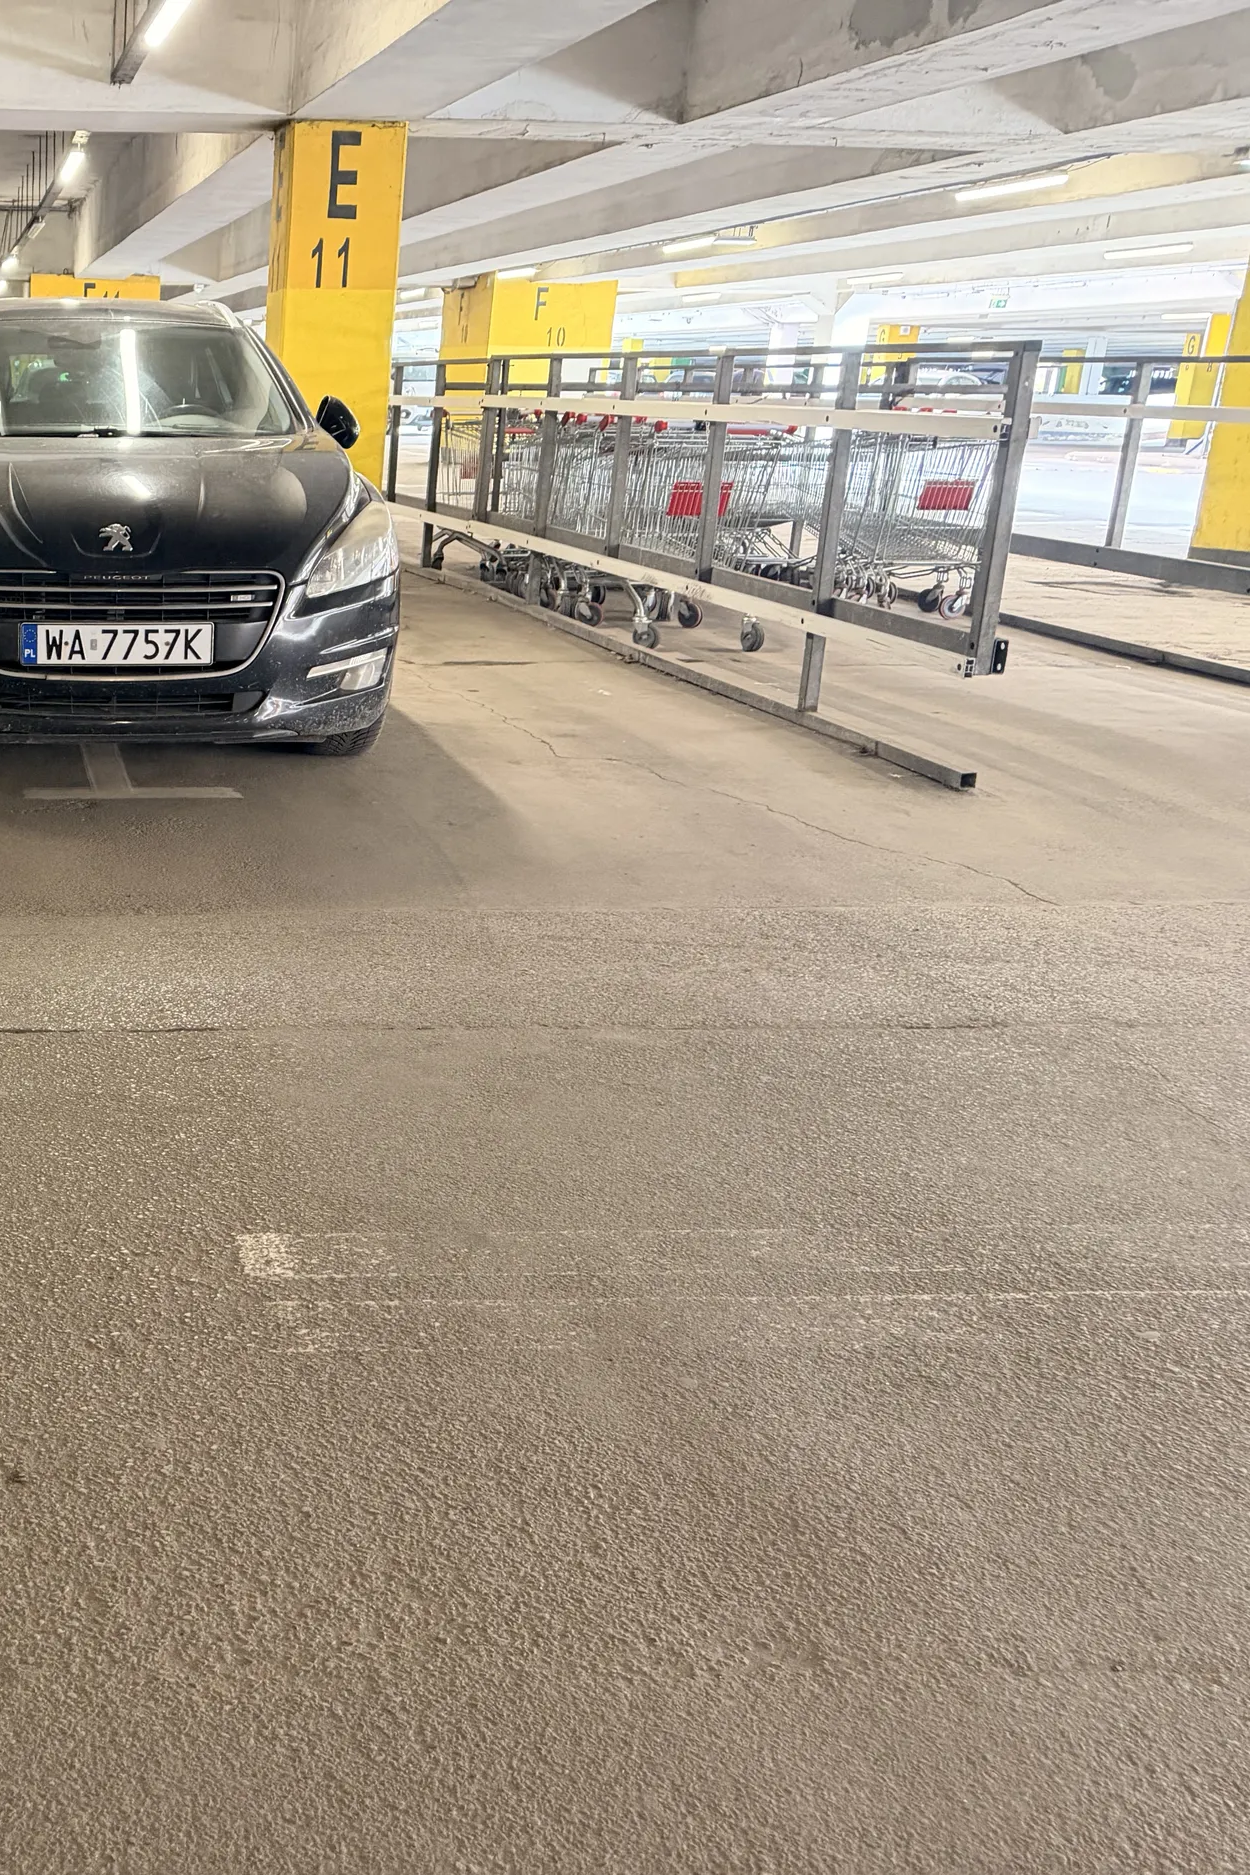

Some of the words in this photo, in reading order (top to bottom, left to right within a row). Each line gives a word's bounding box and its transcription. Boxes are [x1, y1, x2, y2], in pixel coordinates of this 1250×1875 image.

[327, 130, 362, 219] E
[311, 237, 350, 288] 11
[534, 287, 549, 321] F
[546, 327, 566, 347] 10
[1187, 335, 1196, 355] G
[24, 649, 36, 658] PL
[45, 629, 86, 660] WA
[101, 628, 204, 661] 7757K
